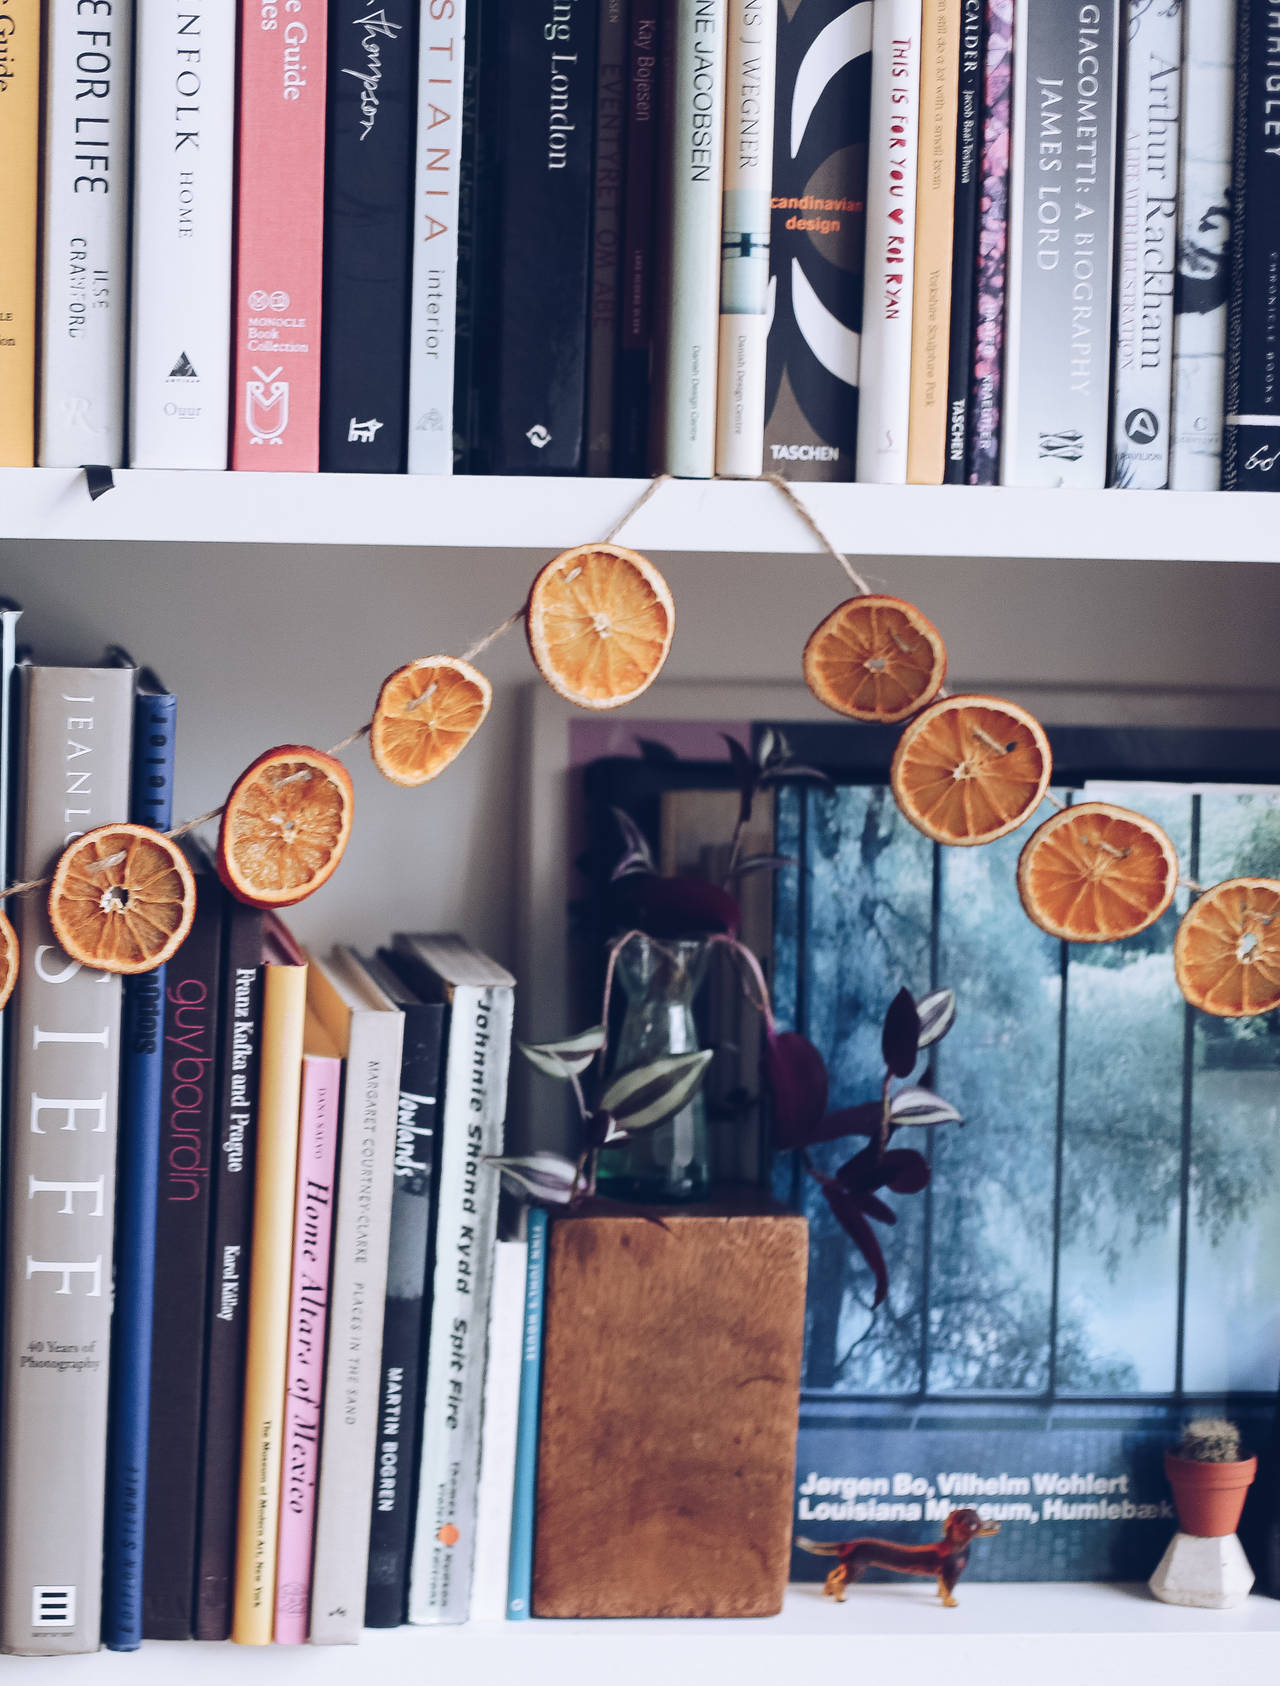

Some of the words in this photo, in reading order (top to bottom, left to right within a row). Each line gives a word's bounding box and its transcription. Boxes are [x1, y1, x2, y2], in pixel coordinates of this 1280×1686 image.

[283, 21, 308, 101] Guide
[637, 20, 657, 51] Kay
[891, 37, 912, 78] THIS
[964, 0, 980, 73] CALDER
[75, 32, 112, 100] FOR
[633, 55, 656, 122] Bojesen
[548, 52, 578, 171] London
[690, 41, 716, 184] JACOBSEN
[736, 56, 763, 171] WEGNER
[890, 89, 909, 105] IS
[961, 90, 975, 119] Jacob
[1036, 77, 1064, 171] JAMES
[1076, 4, 1100, 194] GIACOMETTI:
[1146, 53, 1180, 180] Arthur
[73, 117, 111, 194] LIFE
[888, 117, 909, 149] FOR
[933, 124, 945, 156] small
[177, 171, 194, 239] HOME
[887, 156, 906, 199] YOU
[784, 215, 840, 234] design
[1036, 189, 1062, 272] LORD
[1074, 201, 1095, 221] A
[885, 235, 906, 265] ROB
[68, 237, 87, 339] CRAWFORD
[884, 272, 903, 321] RYAN
[1119, 240, 1138, 370] ILLUSTRATION
[1141, 191, 1178, 370] Rackham
[248, 318, 307, 328] MONOCLE
[248, 328, 280, 339] Book
[425, 268, 445, 360] interior
[1069, 231, 1095, 398] BIOGRAPHY
[248, 340, 309, 353] Collection
[1265, 352, 1275, 403] BOOKS
[770, 445, 839, 461] TASCHEN
[950, 399, 966, 461] TASCHEN
[234, 968, 257, 1017] Franz
[232, 1021, 255, 1071] Kafka
[469, 1000, 492, 1113] Johnnie
[232, 1074, 251, 1108] and
[365, 1060, 380, 1132] MARGARET
[25, 943, 112, 1298] SIEFF
[394, 1091, 437, 1178] lowlands
[461, 1125, 483, 1215] Shand
[301, 1179, 330, 1262] Home
[222, 1245, 241, 1280] Karol
[455, 1225, 477, 1295] Kydd
[298, 1273, 326, 1365] Altars
[351, 1282, 365, 1331] PLACES
[20, 1356, 101, 1372] Photography
[27, 1341, 45, 1353] 40
[46, 1341, 79, 1353] Years
[81, 1340, 97, 1352] of
[347, 1357, 360, 1382] THE
[349, 1335, 361, 1351] IN
[448, 1317, 468, 1374] Spit
[286, 1377, 321, 1409] of
[344, 1388, 357, 1426] SAND
[383, 1367, 404, 1435] MARTIN
[443, 1378, 464, 1431] Fire
[260, 1441, 272, 1484] Museum
[288, 1414, 317, 1514] Mexico
[377, 1441, 400, 1512] BOGREN
[892, 1474, 936, 1499] Bo,
[937, 1473, 1030, 1497] Vilhelm
[1032, 1473, 1129, 1496] Wohlert
[798, 1498, 922, 1522] Louisiana
